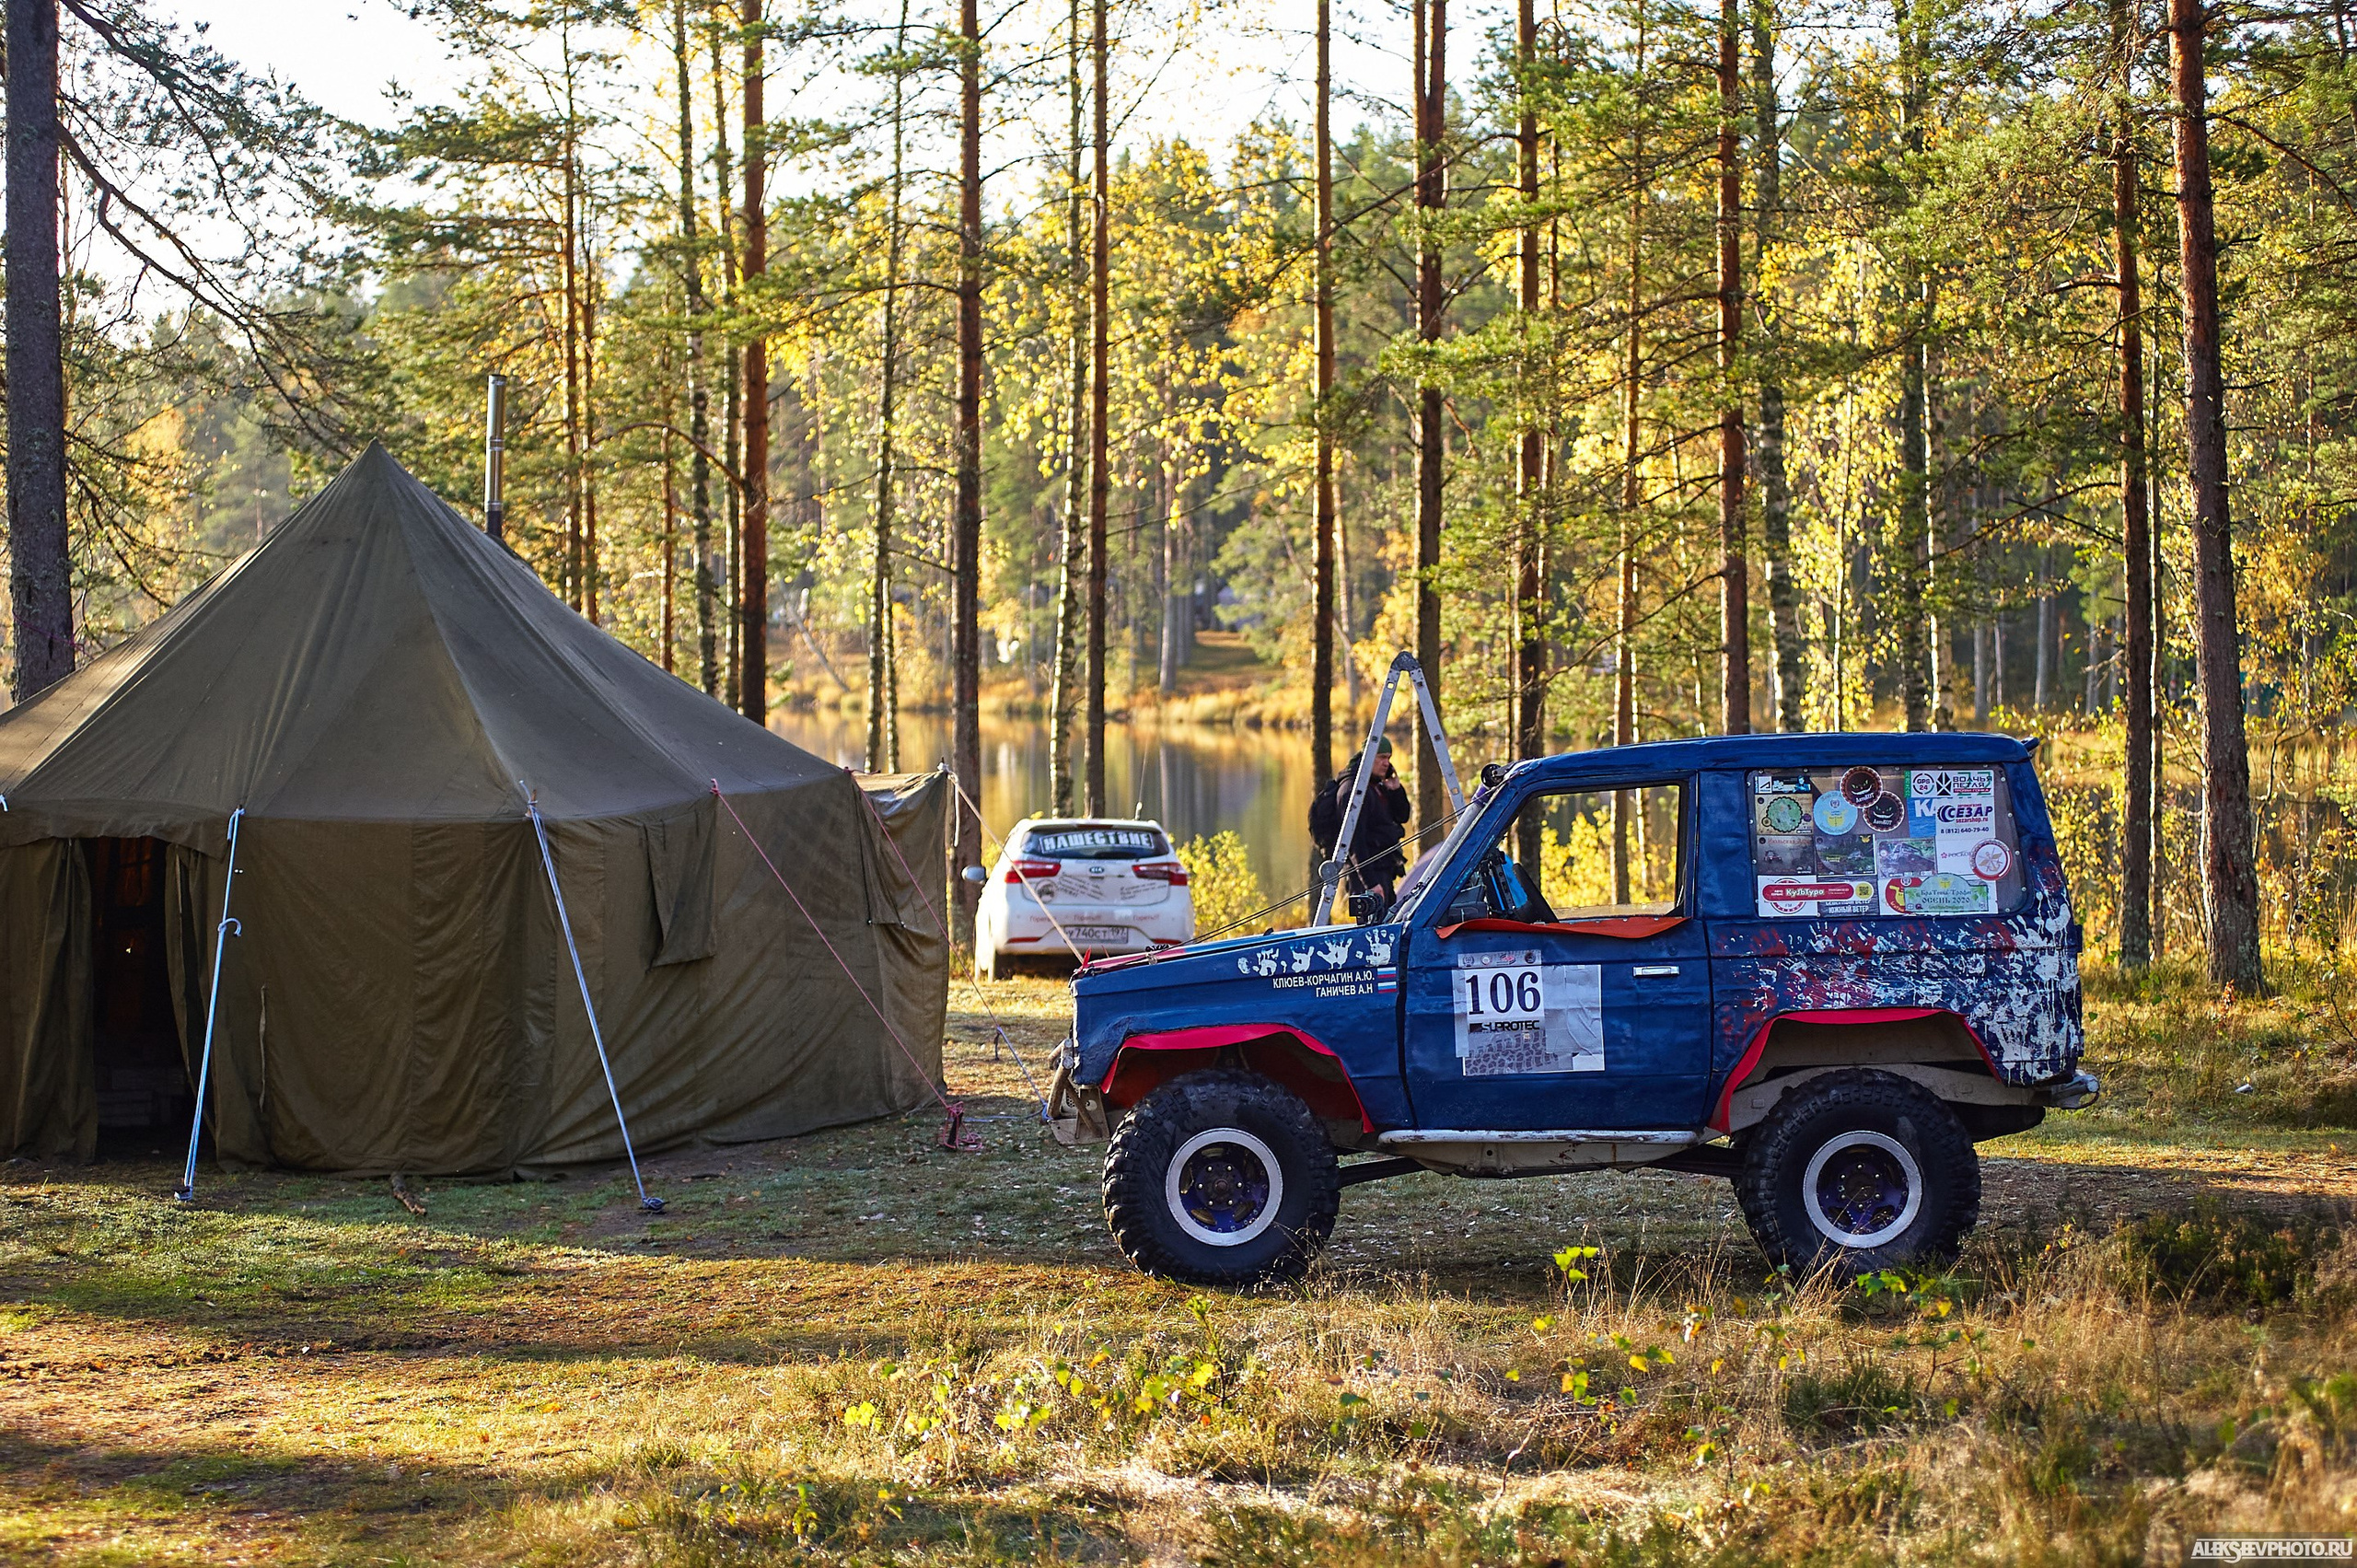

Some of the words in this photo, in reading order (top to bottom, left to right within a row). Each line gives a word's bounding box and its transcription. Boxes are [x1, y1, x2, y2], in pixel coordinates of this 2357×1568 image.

[1947, 806, 1993, 819] СЕЗАР
[1043, 831, 1151, 851] НАШЕСТВИЕ
[1272, 972, 1353, 989] КЛЮЕВ-КОРЧАГИН
[1355, 970, 1375, 981] А.Ю.
[1316, 984, 1356, 997] ГАНИЧЕВ
[1466, 971, 1540, 1016] 106
[1481, 1019, 1540, 1033] SUPROTEC
